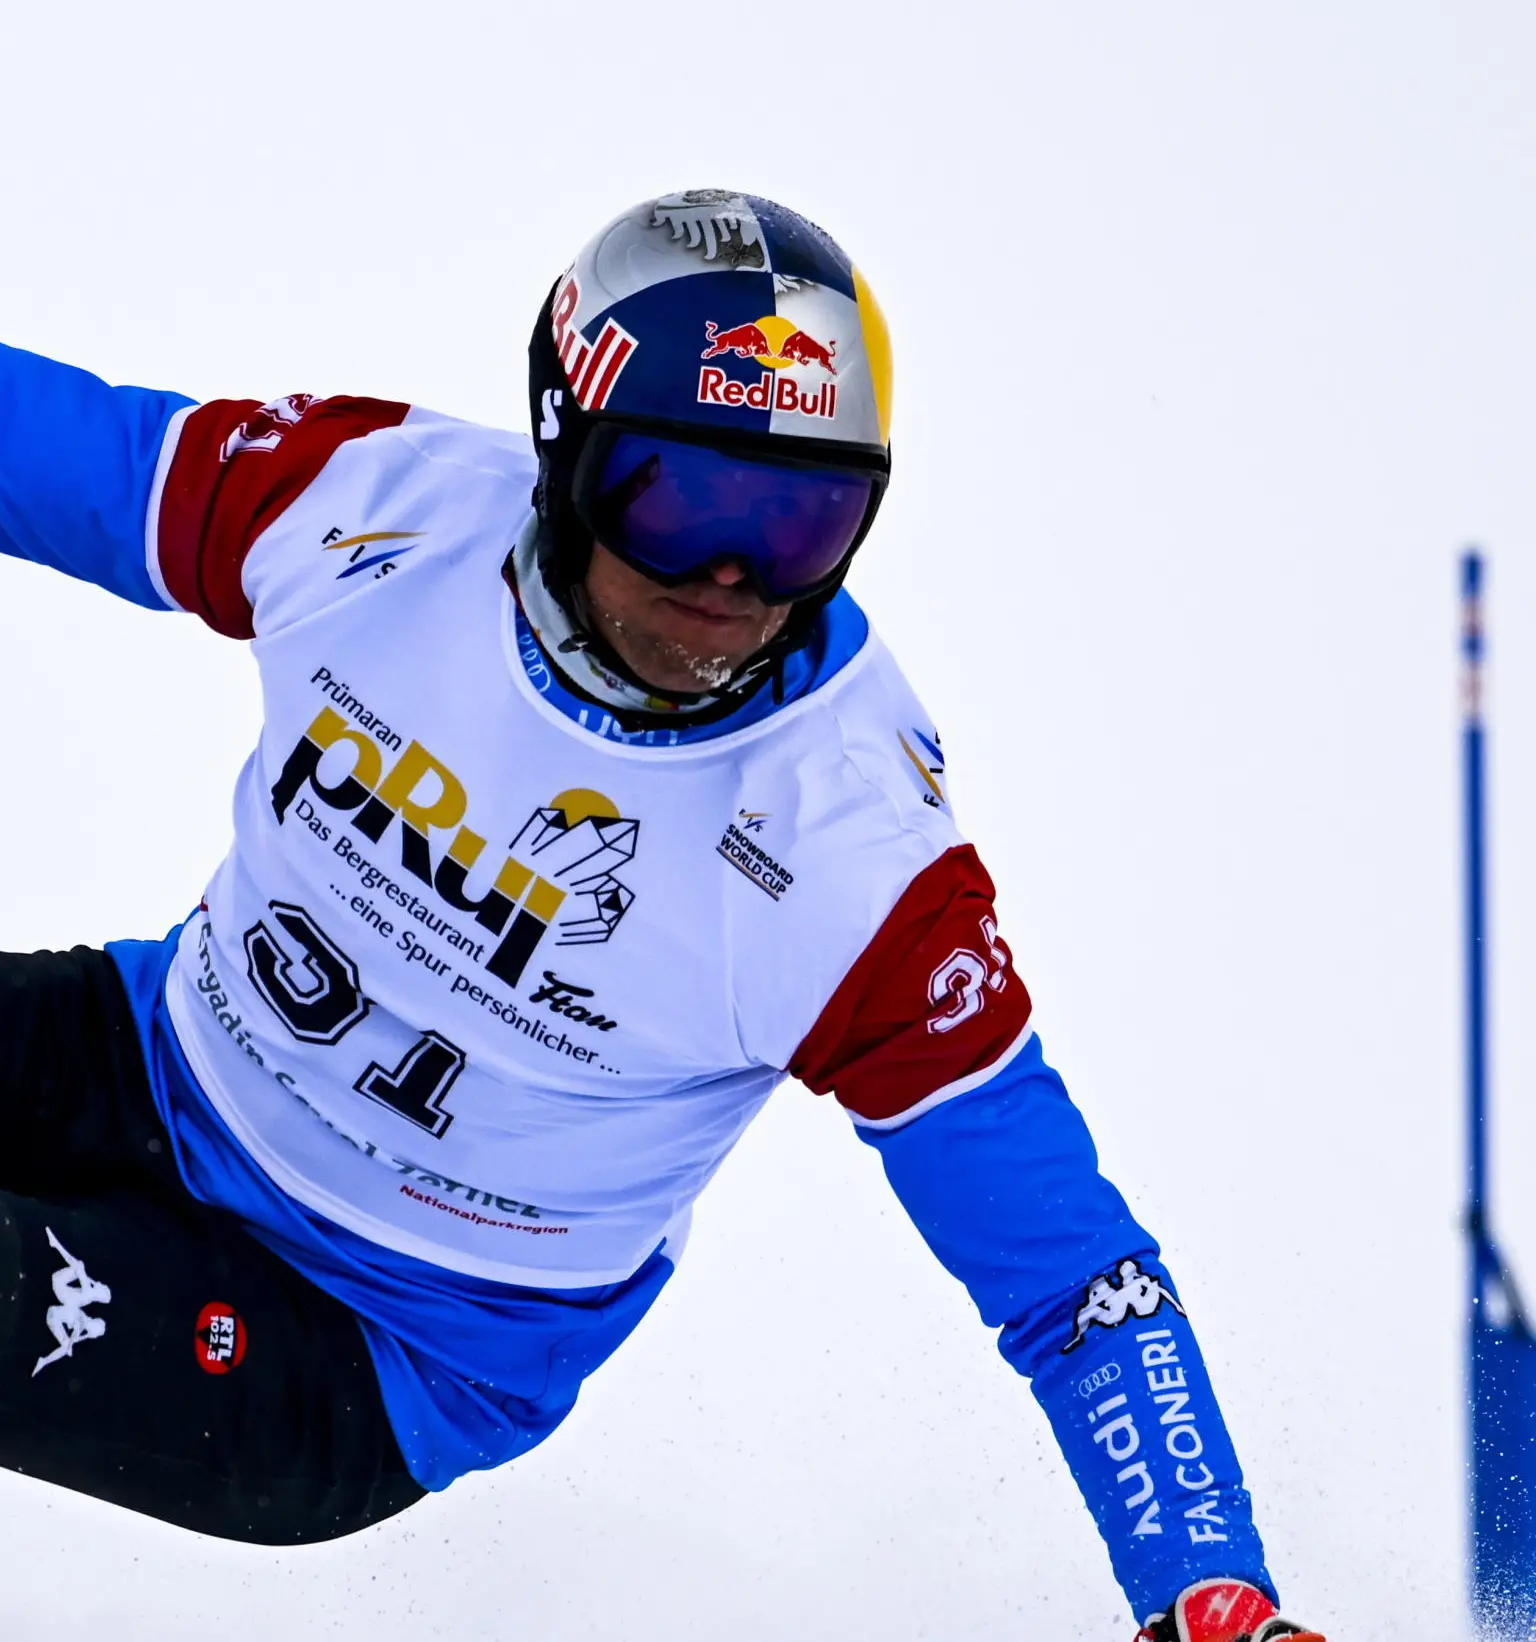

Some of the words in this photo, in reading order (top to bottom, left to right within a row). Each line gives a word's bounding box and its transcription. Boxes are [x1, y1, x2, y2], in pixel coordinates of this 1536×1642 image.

[698, 367, 770, 410] Red
[776, 374, 836, 418] Bull
[310, 667, 403, 752] Prümaran
[295, 799, 330, 843] Das
[333, 835, 485, 963] Bergrestaurant
[720, 834, 762, 875] WORLD
[762, 872, 787, 894] CUP
[726, 824, 794, 885] SNOWBOARD
[396, 931, 452, 977] Spur
[399, 1184, 569, 1235] Nationalparkregion
[207, 1315, 219, 1360] 102.5
[217, 1316, 234, 1361] RTL
[1088, 1393, 1163, 1536] Audi
